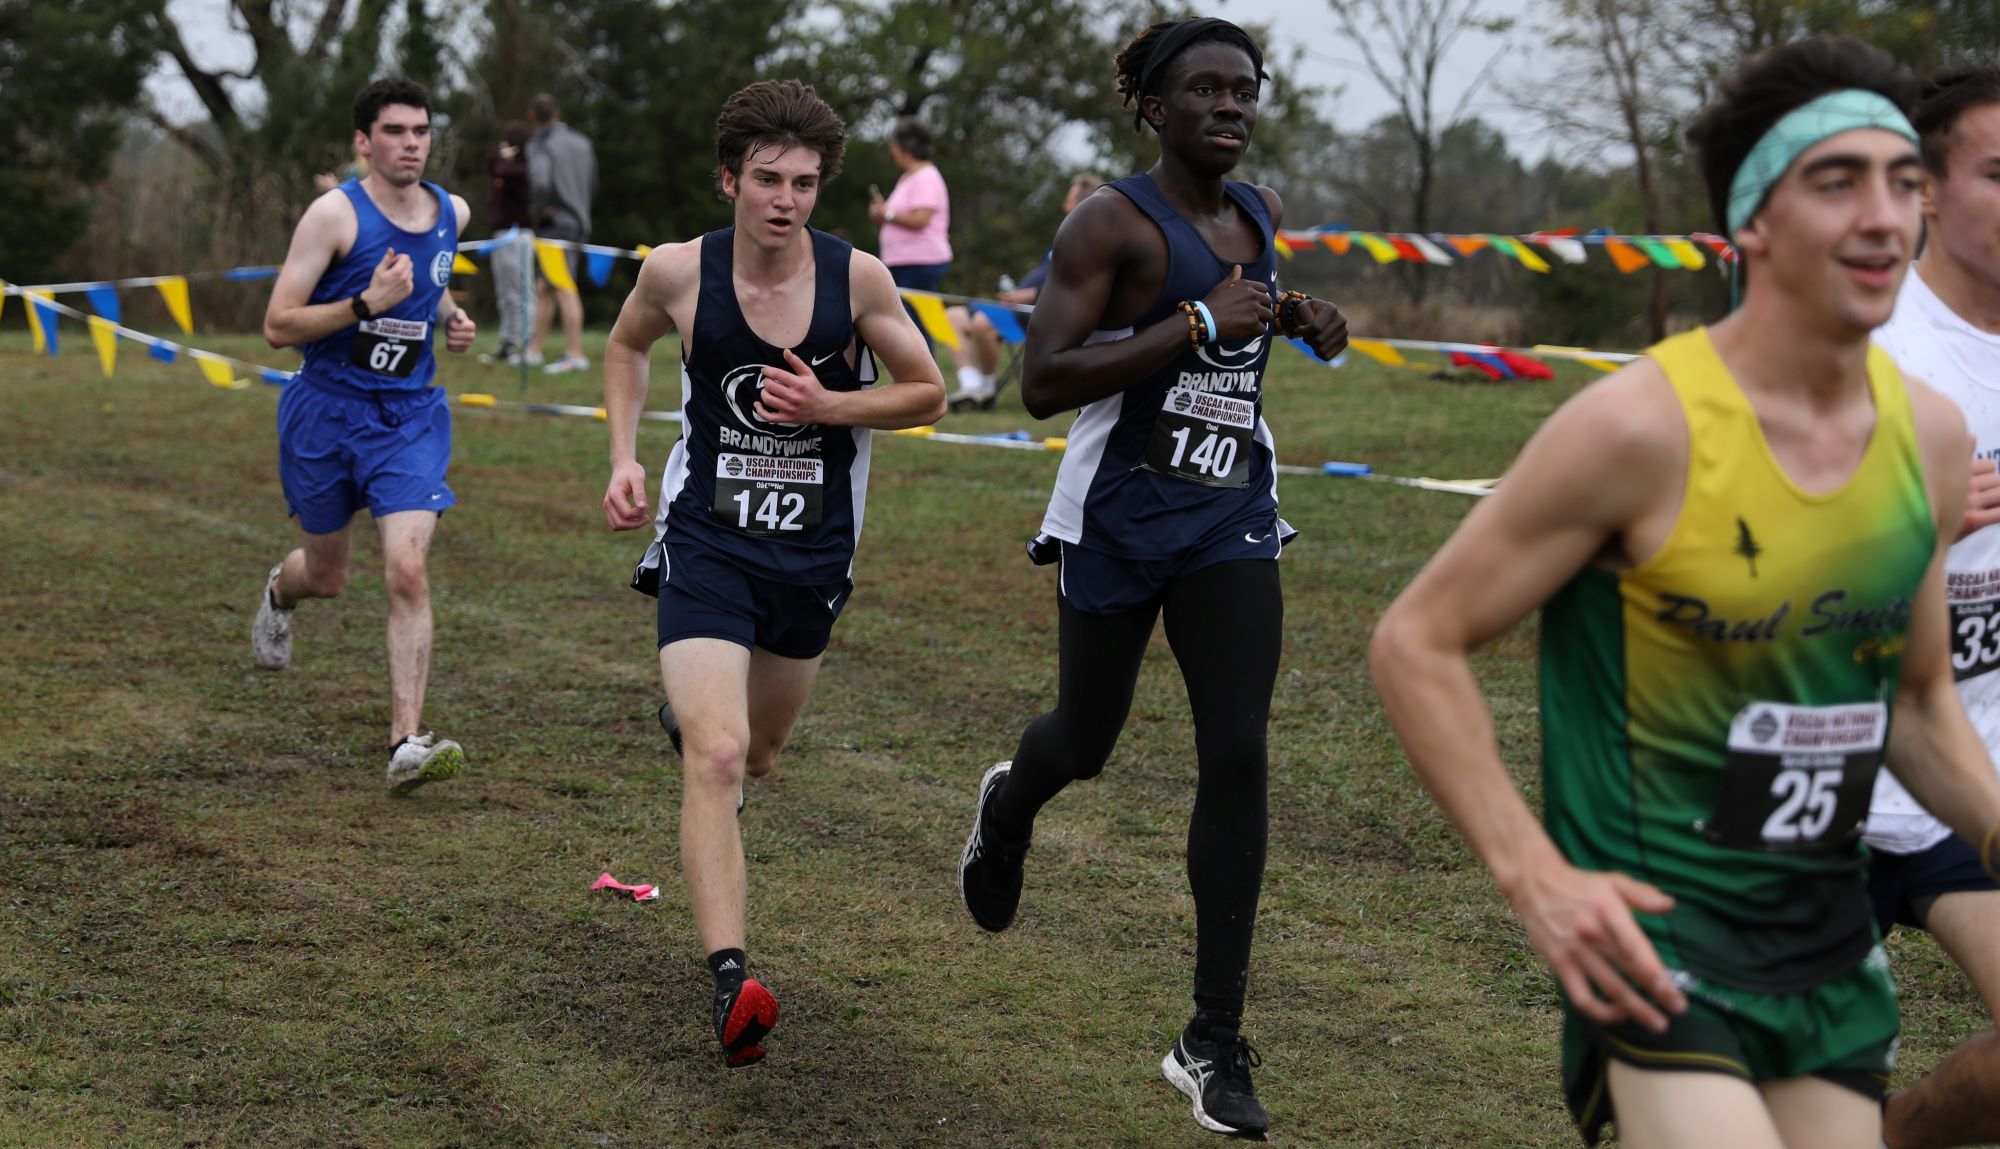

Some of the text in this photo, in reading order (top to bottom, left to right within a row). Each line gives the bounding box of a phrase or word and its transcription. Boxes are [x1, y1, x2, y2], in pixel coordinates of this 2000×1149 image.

[370, 342, 408, 371] 67
[1191, 404, 1252, 426] CHAMPIONSHIPS
[1195, 394, 1253, 415] USCAA NATIONAL
[720, 426, 822, 456] BRANDYWINE
[1206, 423, 1219, 431] Osei
[746, 457, 776, 469] USCAA
[777, 459, 817, 471] NATIONAL
[1170, 426, 1238, 478] 140
[745, 467, 817, 481] CHAMPIONSHIPS
[733, 489, 805, 531] 142
[1657, 592, 1793, 641] Paul
[1761, 769, 1844, 841] 25
